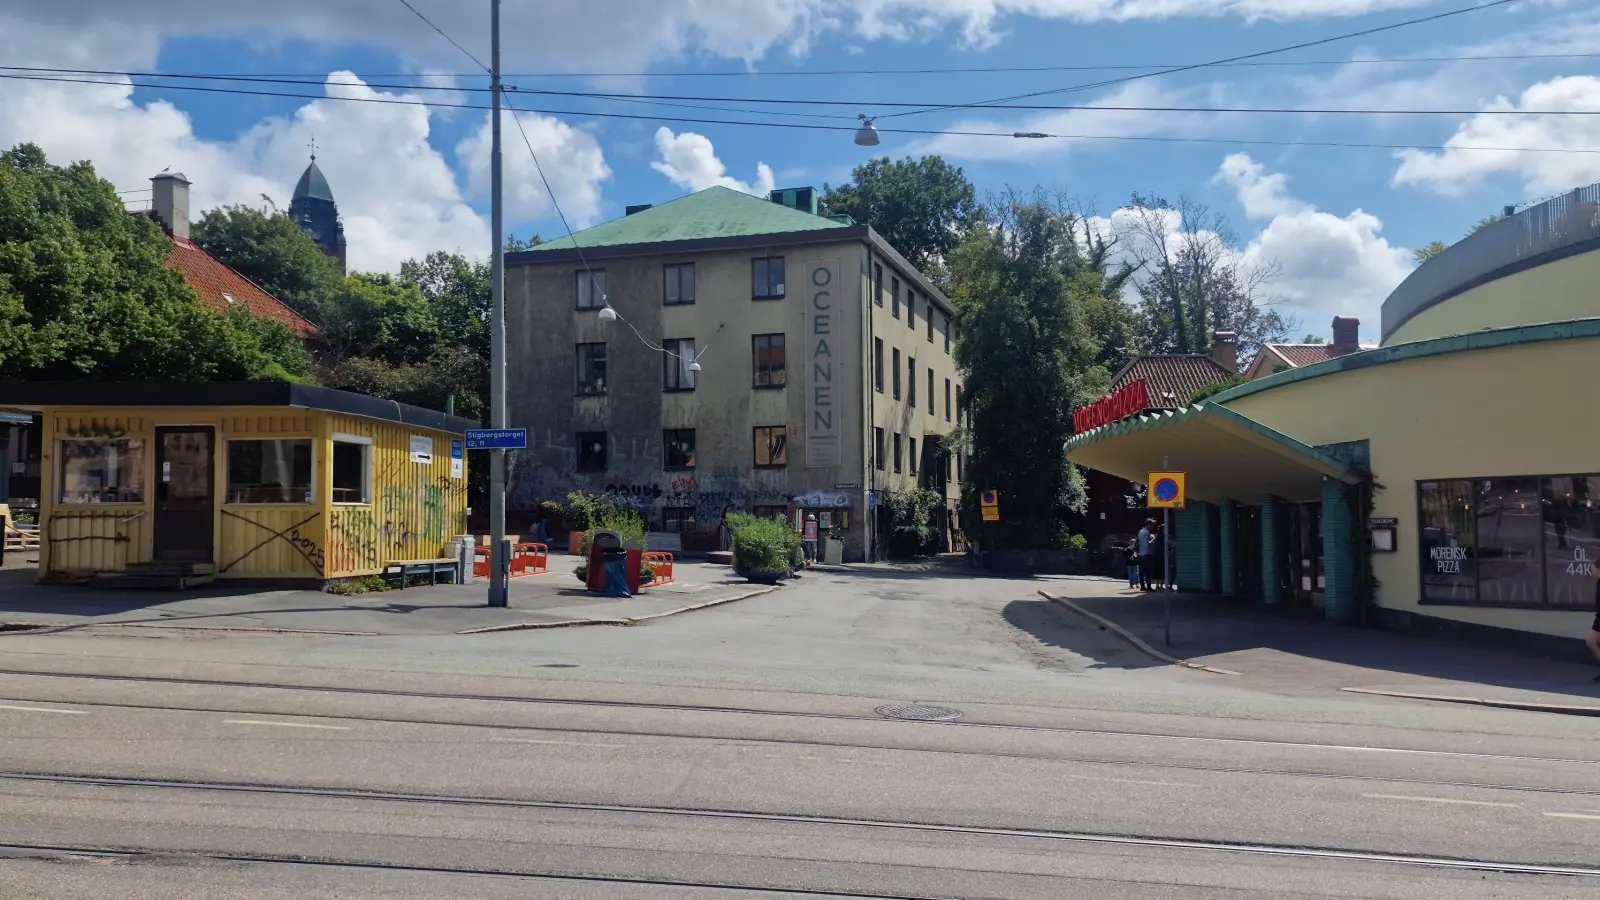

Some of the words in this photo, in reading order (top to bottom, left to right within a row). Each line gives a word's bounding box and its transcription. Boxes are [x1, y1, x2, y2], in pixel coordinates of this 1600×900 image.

[812, 267, 832, 430] OCEANEN
[1073, 395, 1112, 434] MORENO
[1112, 379, 1149, 418] PIZZA
[467, 431, 524, 440] Stigbergstorget
[291, 530, 325, 568] 2025
[1430, 546, 1467, 560] MORENSK
[1574, 545, 1590, 562] ÖL
[1437, 560, 1460, 573] PIZZA
